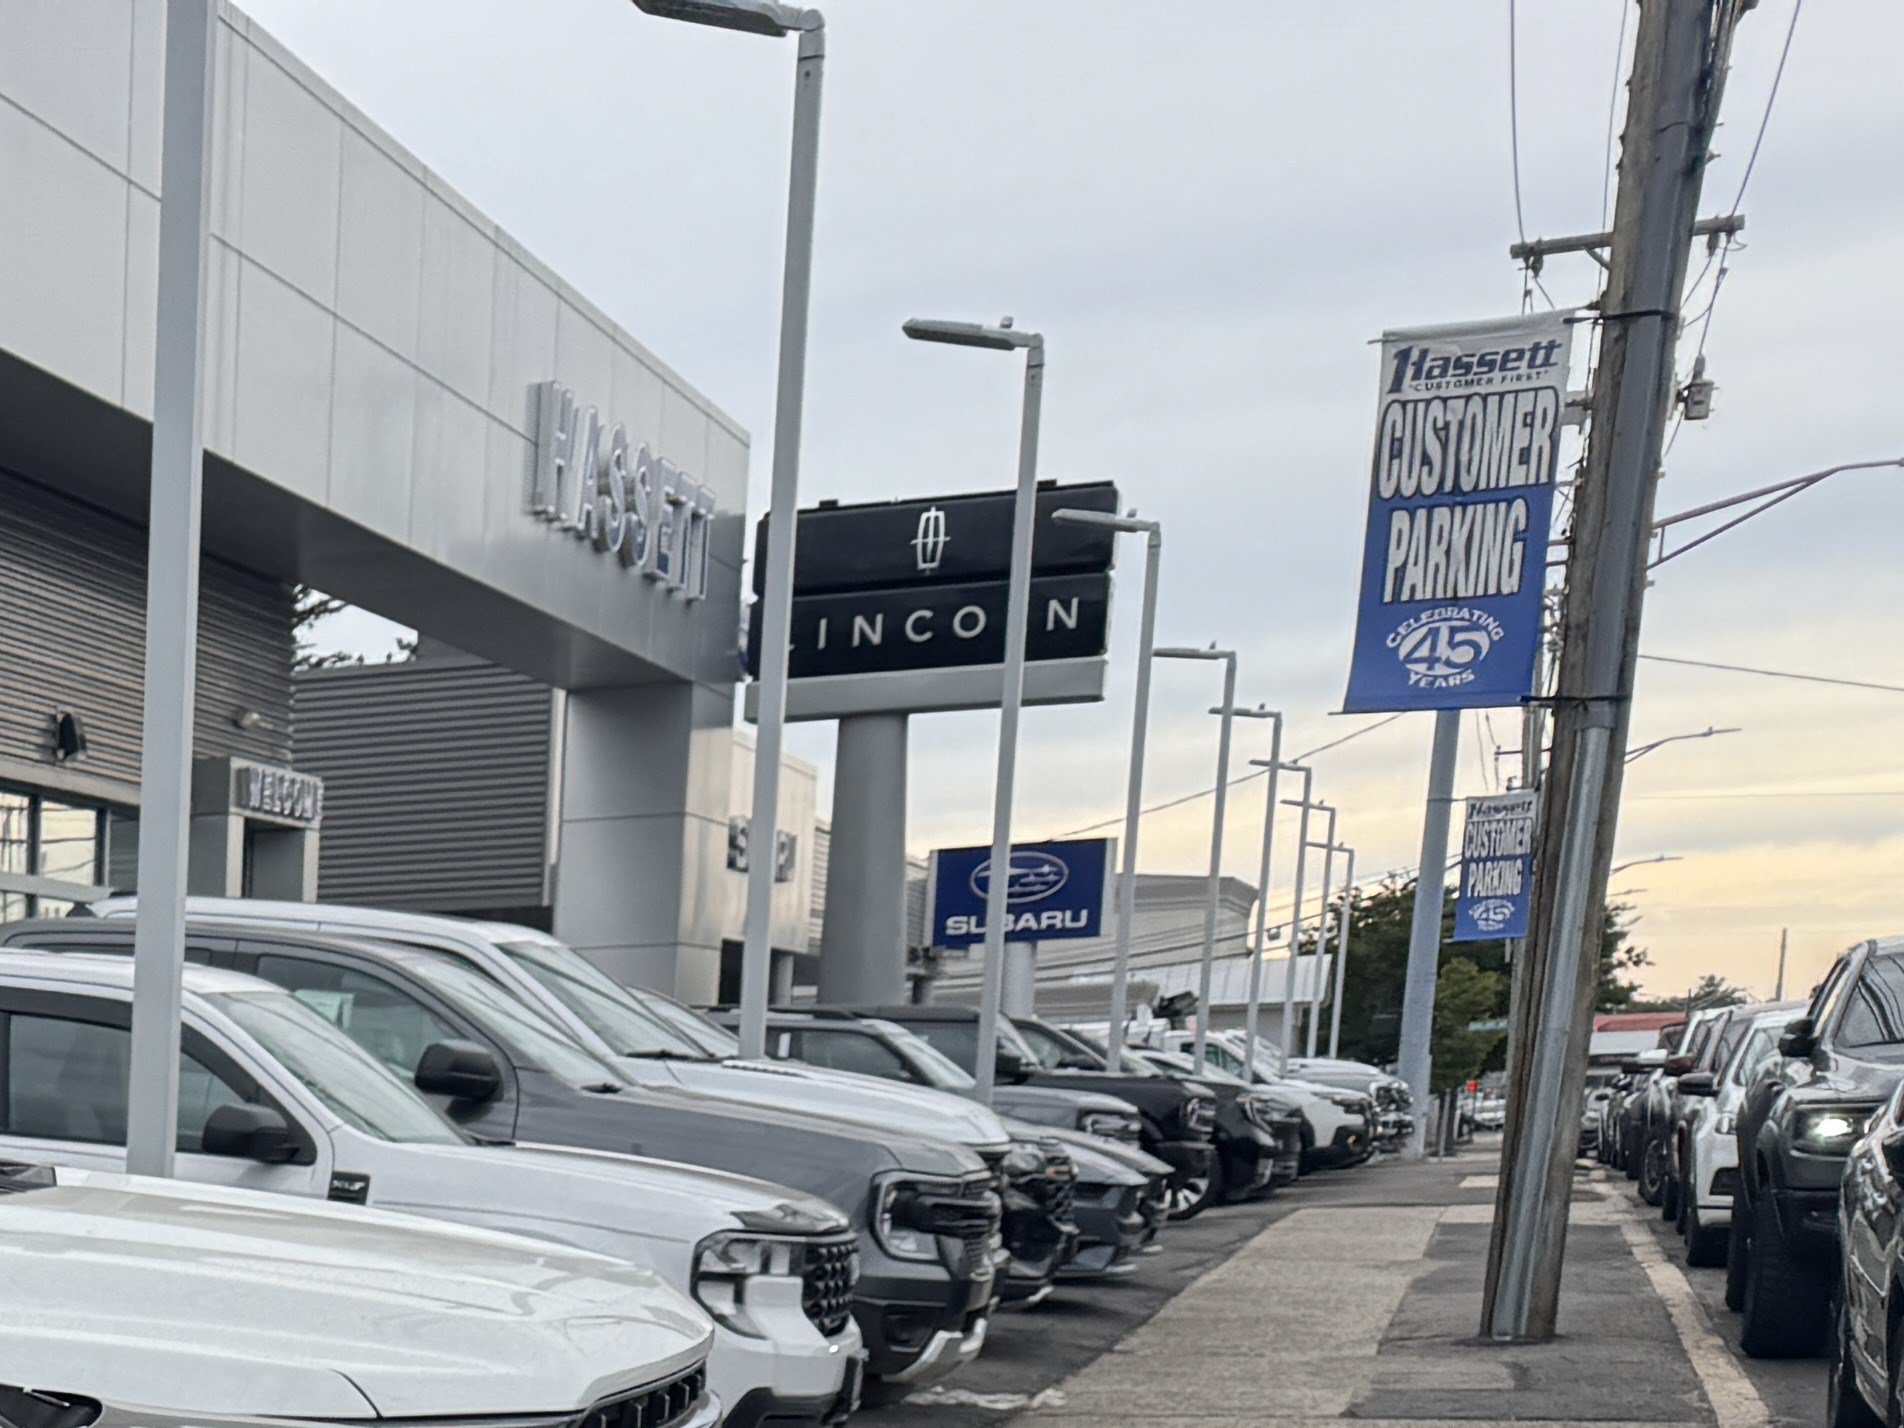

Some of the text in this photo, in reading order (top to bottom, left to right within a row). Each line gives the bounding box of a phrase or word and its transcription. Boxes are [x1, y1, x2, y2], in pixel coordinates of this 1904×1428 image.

[1387, 339, 1563, 394] Hassett
[1378, 389, 1558, 499] CUSTOMER
[528, 379, 716, 601] HASSETT
[1383, 499, 1529, 603] PARKING
[790, 597, 1080, 650] INCON
[1386, 606, 1505, 648] CELEBRATING
[1402, 624, 1484, 672] 45
[1408, 669, 1475, 689] YEARS
[1464, 817, 1533, 859] CUSTOMER
[1467, 858, 1524, 898] PARKING
